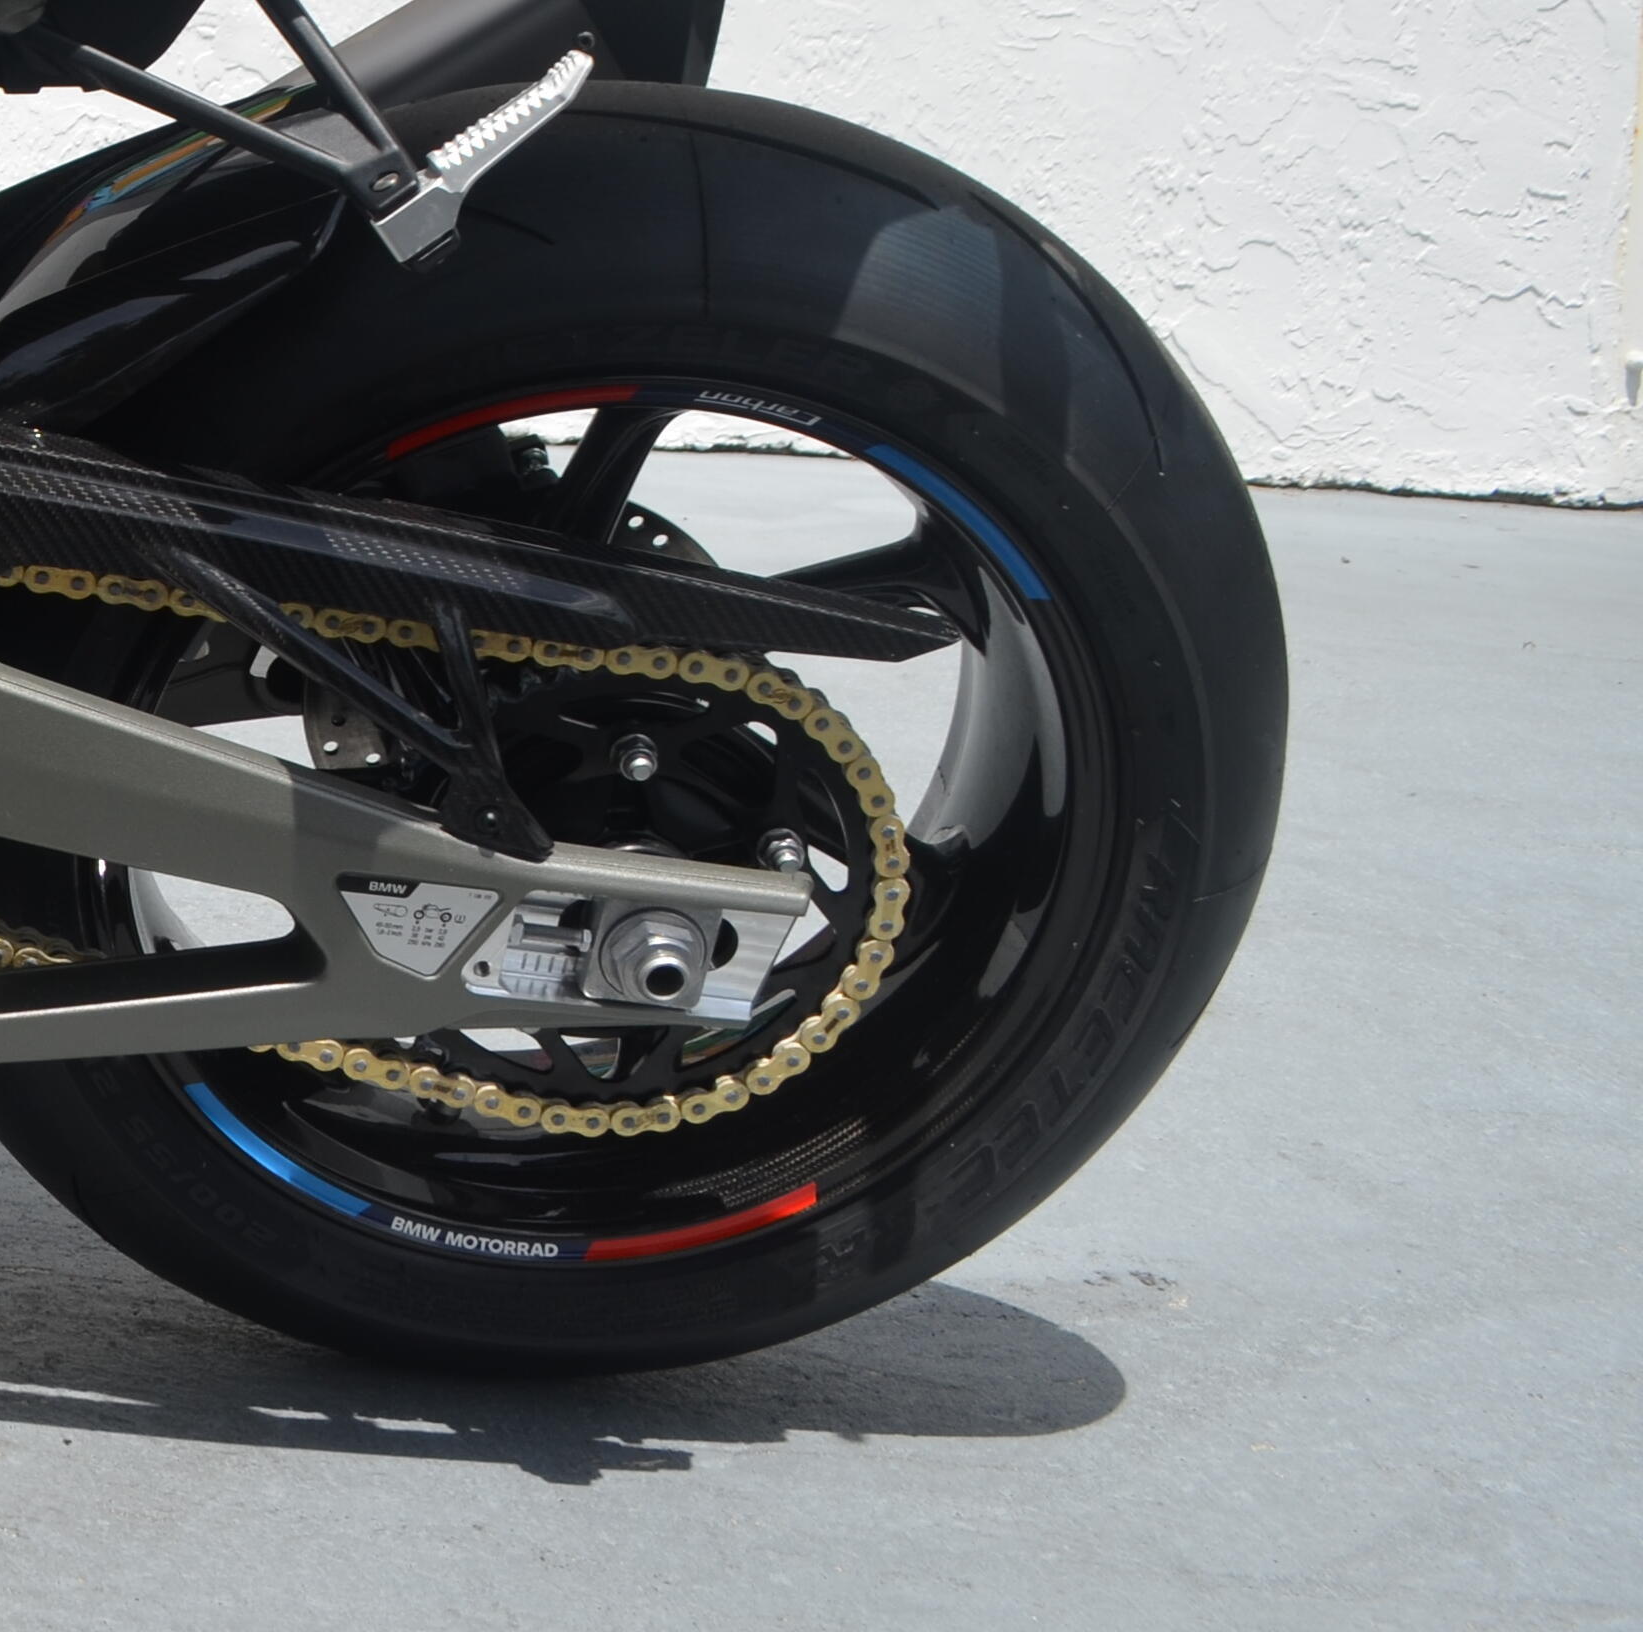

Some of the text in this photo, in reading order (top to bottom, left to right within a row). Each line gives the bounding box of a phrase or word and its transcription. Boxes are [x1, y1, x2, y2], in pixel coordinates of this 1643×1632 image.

[694, 389, 822, 426] Carbon
[368, 880, 408, 895] BMW
[390, 1216, 559, 1258] BMW MOTORRAD
